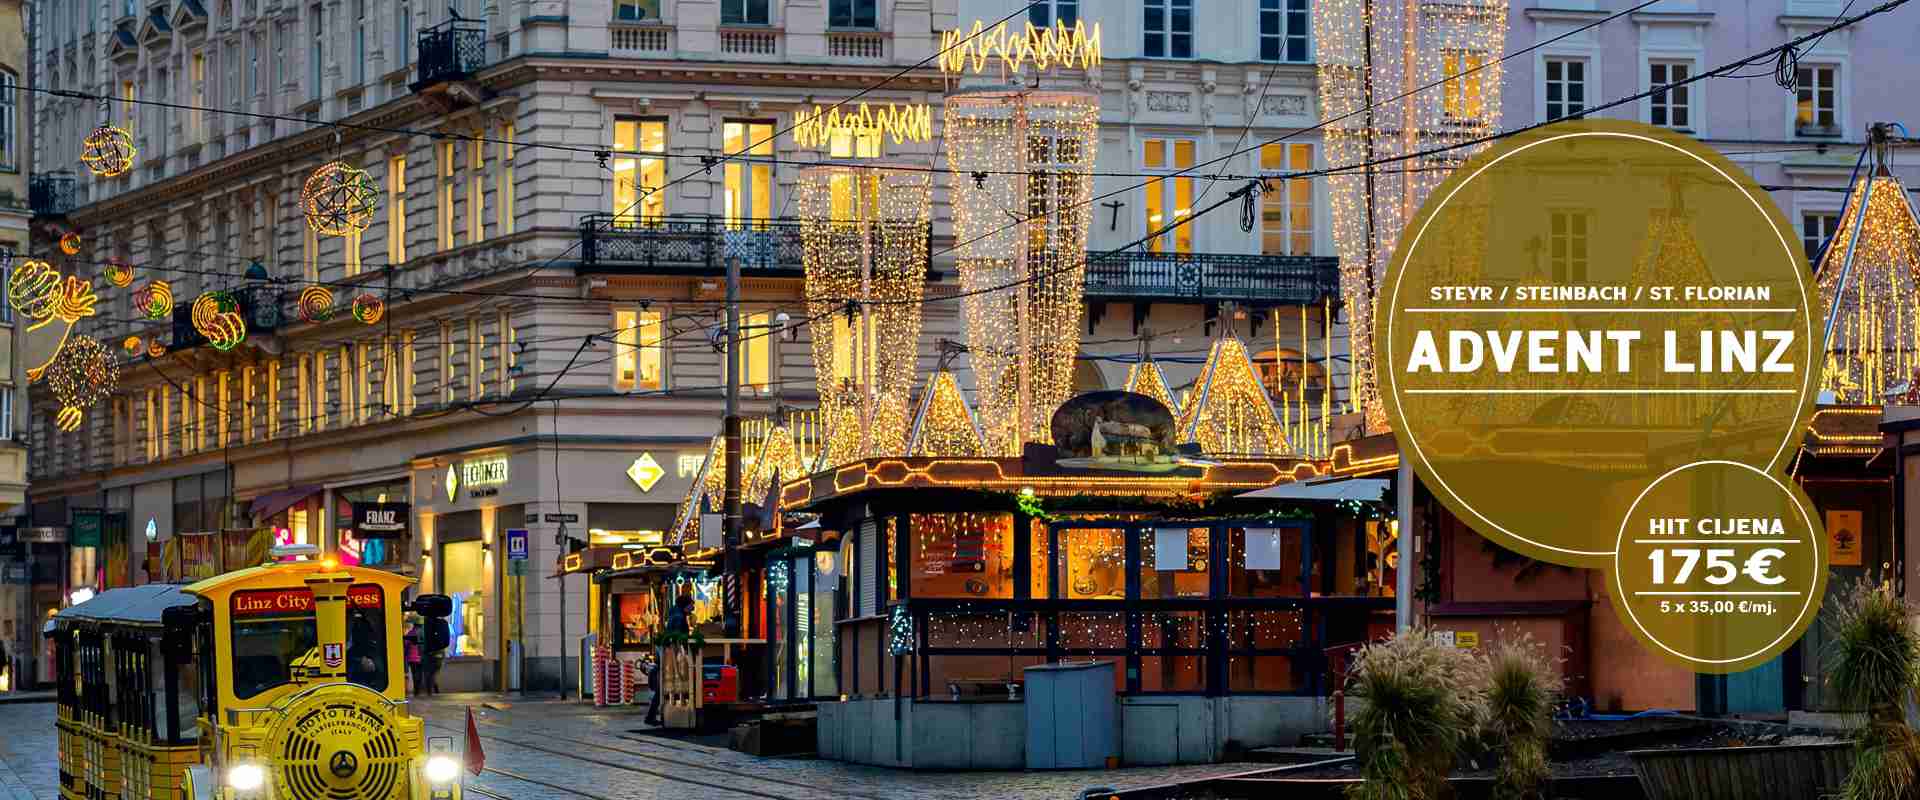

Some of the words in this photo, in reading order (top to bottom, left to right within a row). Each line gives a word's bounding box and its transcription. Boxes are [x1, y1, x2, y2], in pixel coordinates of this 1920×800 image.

[366, 510, 396, 524] FRANZ
[236, 596, 272, 610] Linz
[276, 594, 311, 610] City
[299, 709, 337, 733] DOTTO
[343, 709, 382, 732] TRAINS
[331, 728, 352, 736] ITALY
